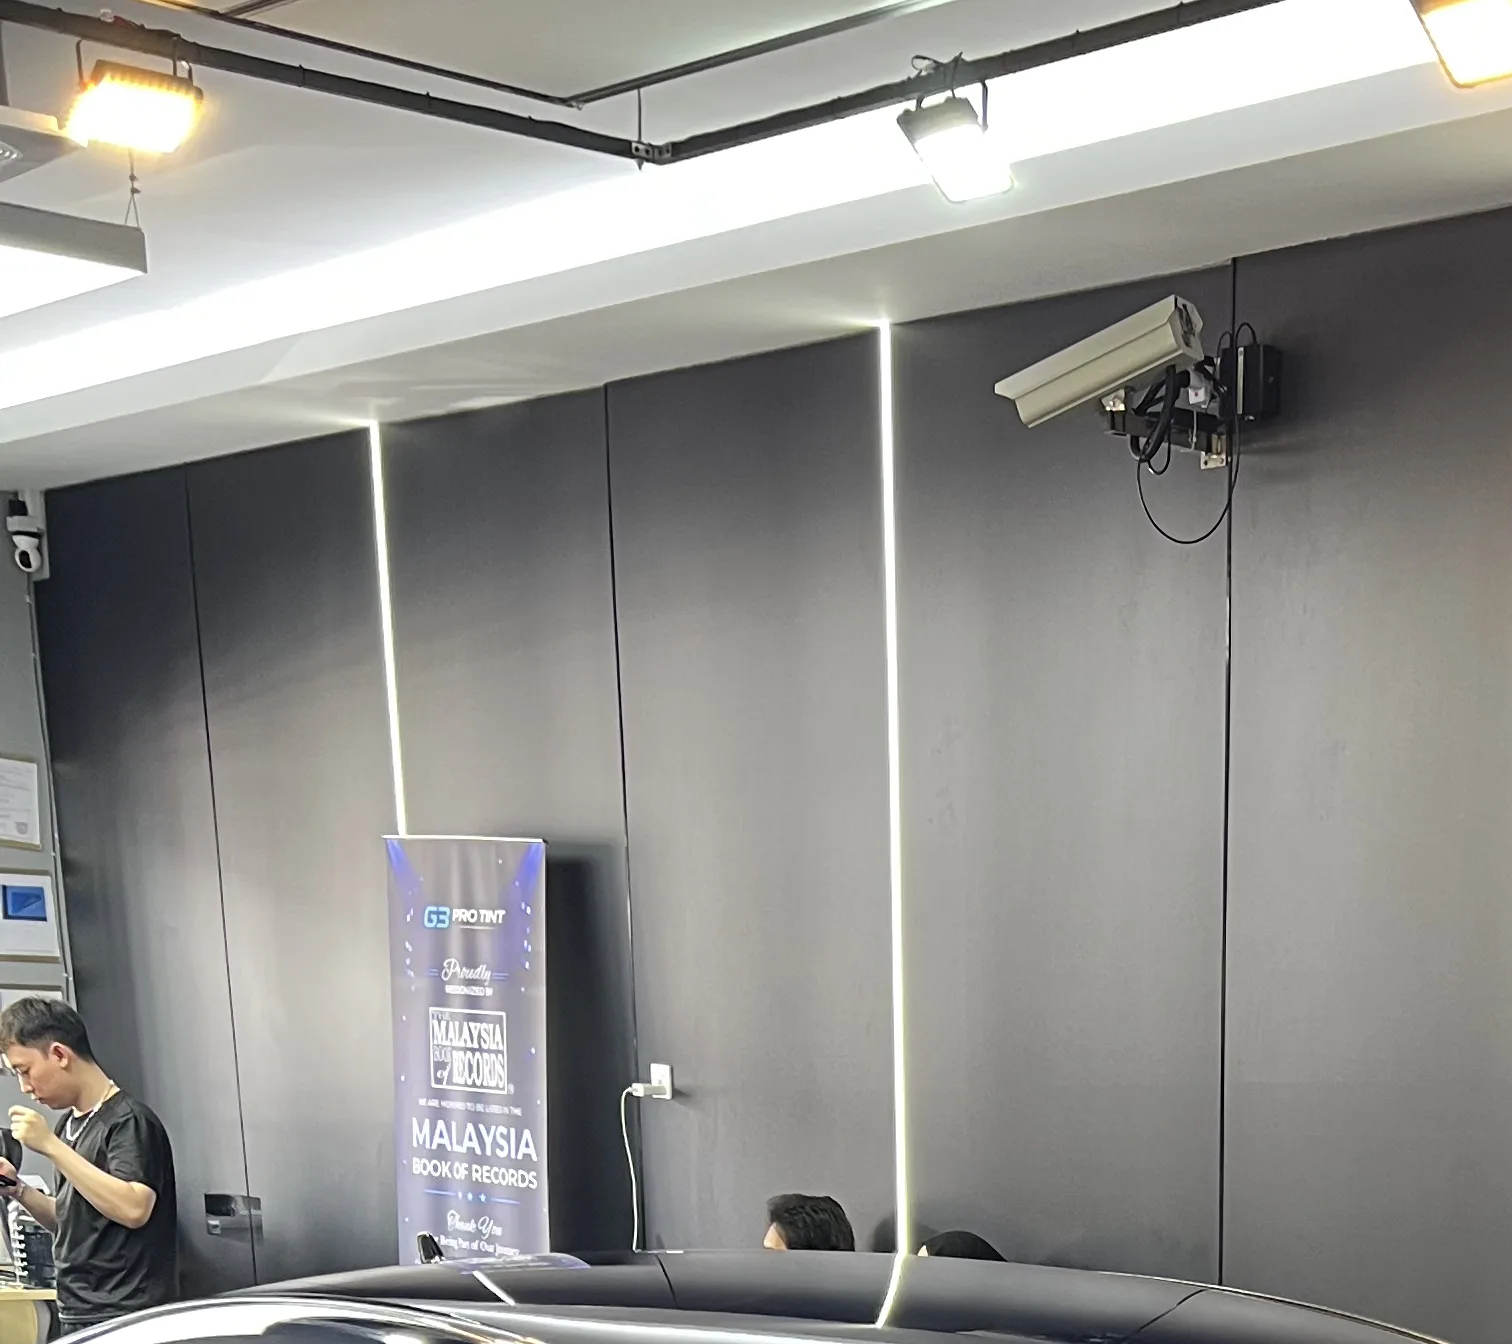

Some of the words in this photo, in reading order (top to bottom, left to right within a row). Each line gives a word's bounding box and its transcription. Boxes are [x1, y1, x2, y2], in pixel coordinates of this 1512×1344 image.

[424, 906, 450, 928] G3
[452, 908, 477, 923] PRO
[479, 909, 506, 924] TINT
[441, 958, 492, 986] Proudly
[432, 1020, 504, 1050] MALAYSIA
[452, 1050, 505, 1089] RECORDS
[412, 1116, 538, 1162] MALAYSIA
[412, 1156, 452, 1178] BOOK
[453, 1161, 469, 1180] OF
[471, 1164, 538, 1190] RECORDS
[447, 1209, 476, 1233] Thank
[478, 1215, 502, 1240] You
